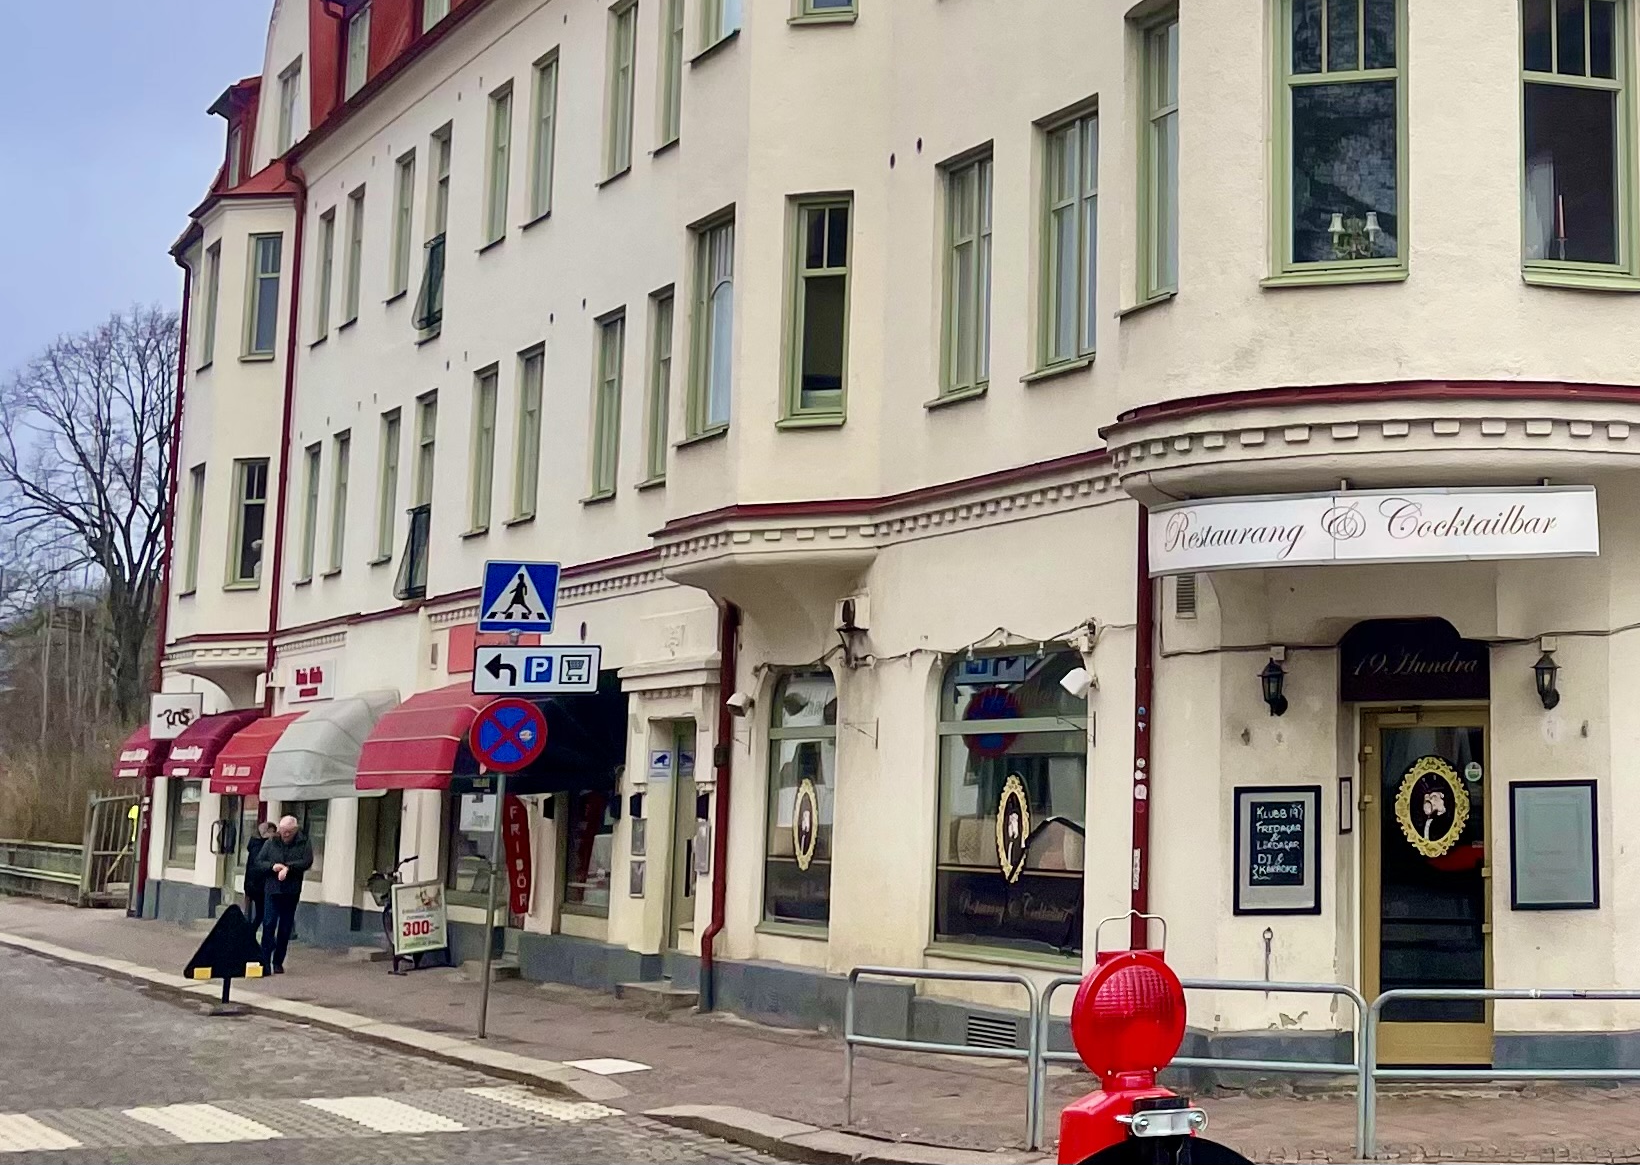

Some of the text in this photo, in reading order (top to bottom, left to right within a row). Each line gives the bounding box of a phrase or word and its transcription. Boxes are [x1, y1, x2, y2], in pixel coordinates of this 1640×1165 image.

[1164, 497, 1557, 560] Restaurang & Cocktailbar
[530, 658, 549, 681] P
[1354, 646, 1477, 676] 19 Hundra
[1256, 806, 1287, 819] KLUBB
[1256, 821, 1302, 834] FREDAGAR
